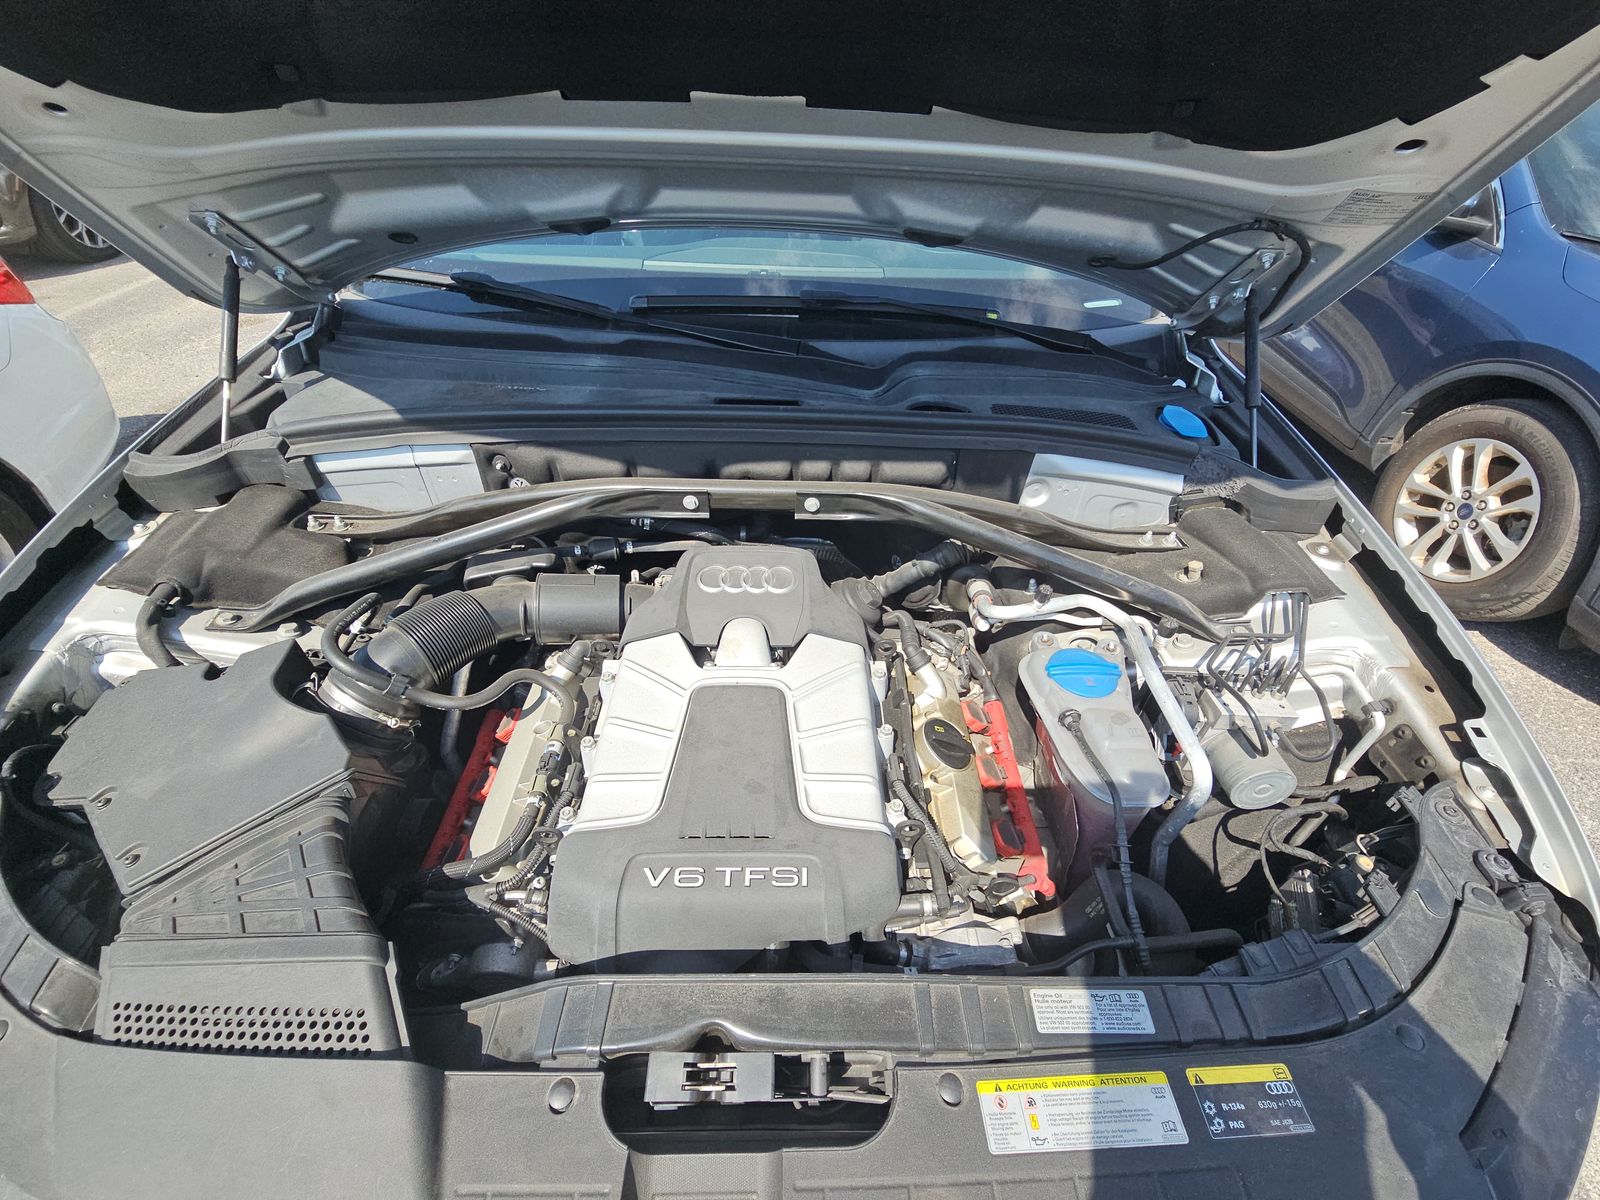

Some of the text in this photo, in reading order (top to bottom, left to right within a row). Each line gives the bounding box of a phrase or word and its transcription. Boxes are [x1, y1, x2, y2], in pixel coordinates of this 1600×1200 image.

[644, 866, 809, 888] V6 TFSI
[1006, 1076, 1147, 1090] ACHTUNG WARNING ATTENTION
[1221, 1102, 1246, 1110] R-134a
[1258, 1100, 1278, 1110] 630g
